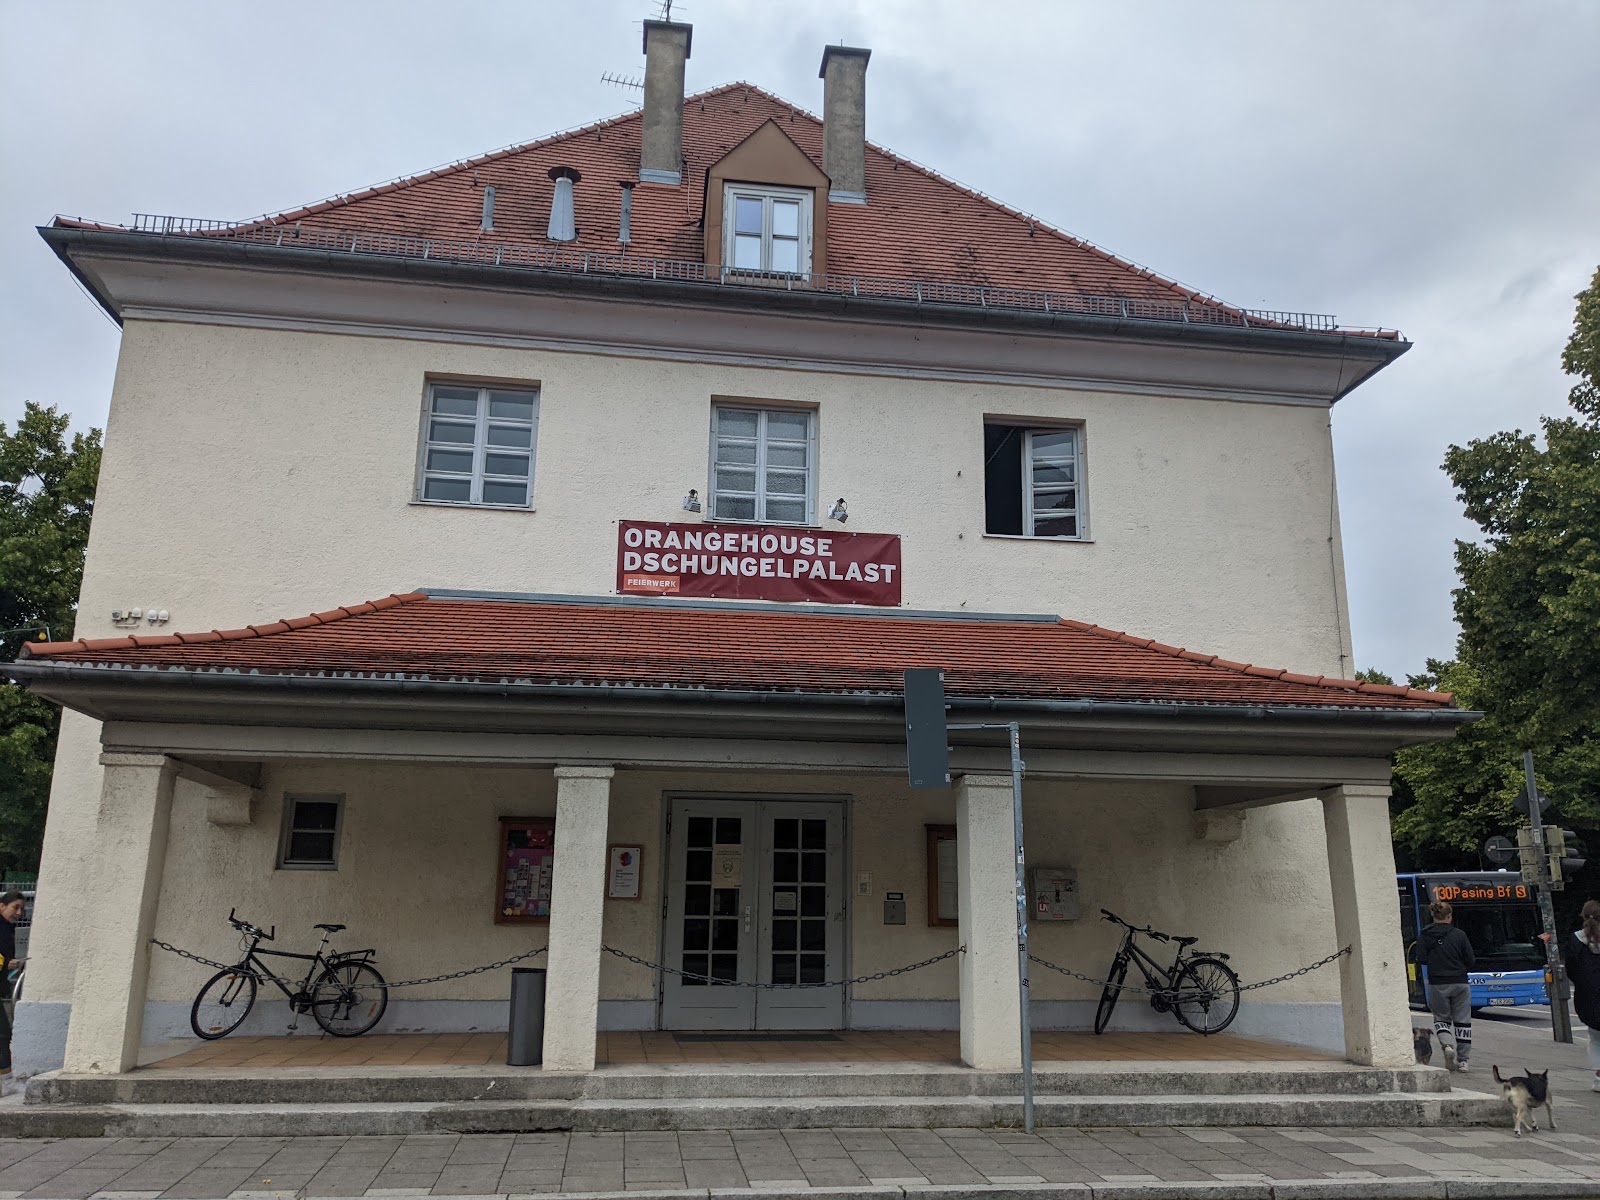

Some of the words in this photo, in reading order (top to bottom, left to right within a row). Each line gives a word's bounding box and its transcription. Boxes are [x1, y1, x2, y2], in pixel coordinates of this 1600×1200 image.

[624, 527, 833, 557] ORANGEHOUSE
[623, 551, 896, 584] DSCHUNGELPALAST
[627, 578, 677, 588] FEIERWERK
[1432, 885, 1453, 900] 130
[1452, 885, 1494, 899] Pasing
[1497, 885, 1511, 898] Bf
[1515, 885, 1527, 898] S
